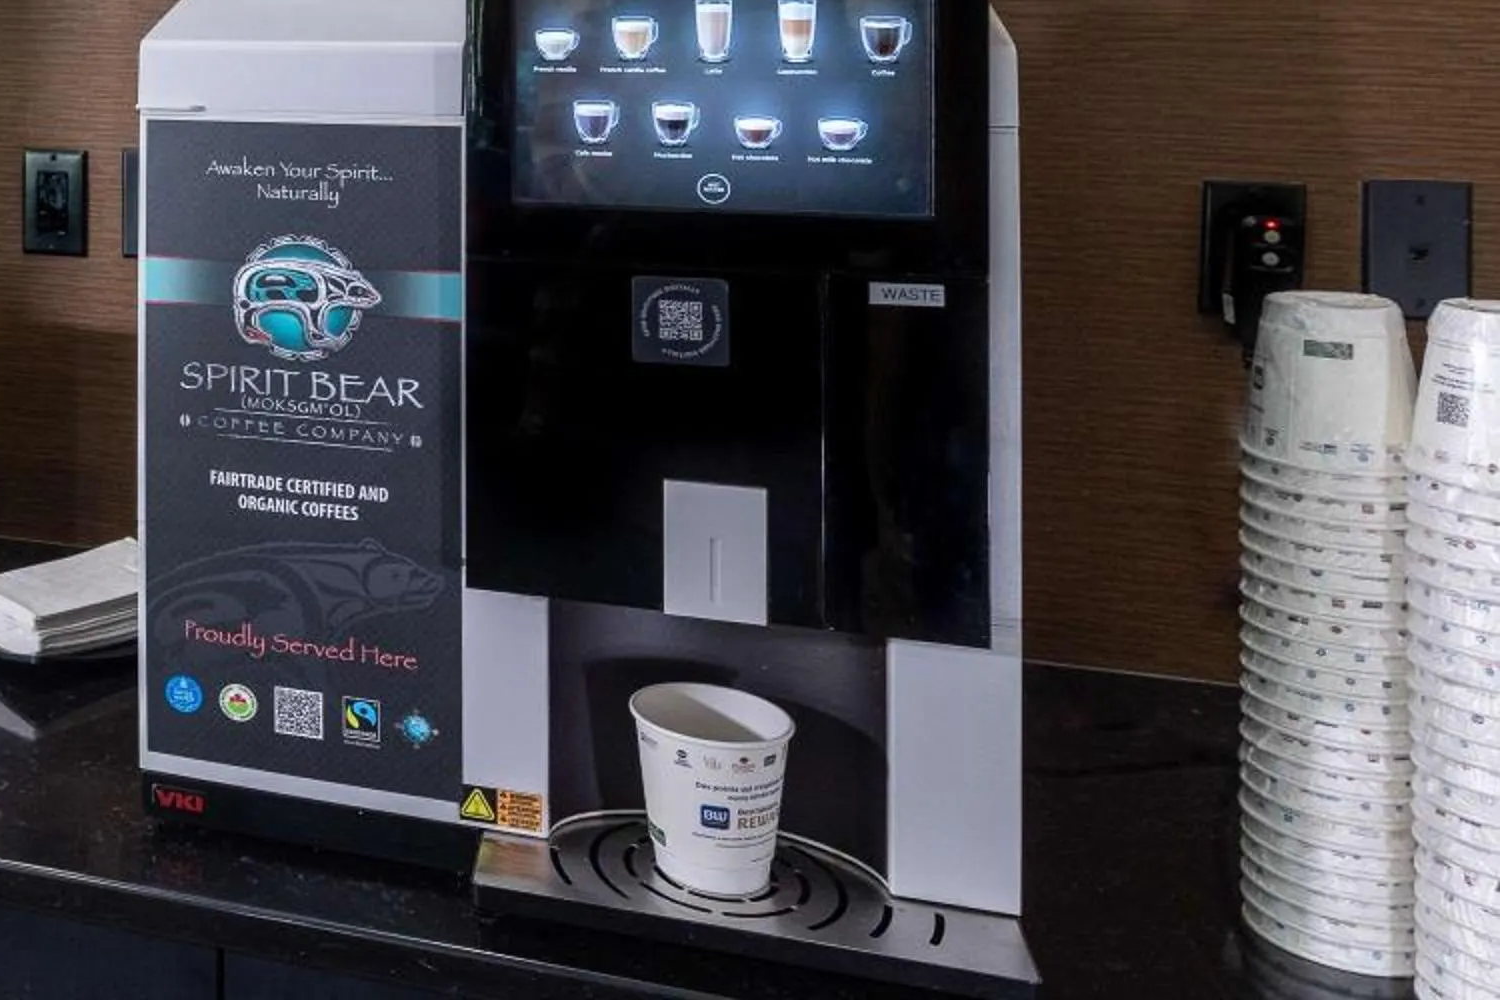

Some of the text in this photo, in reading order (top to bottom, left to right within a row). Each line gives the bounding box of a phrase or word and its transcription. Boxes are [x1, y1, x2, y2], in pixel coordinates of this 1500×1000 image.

[205, 155, 393, 188] Awaken Your Spirit...
[257, 180, 340, 209] Naturally
[881, 287, 941, 302] WASTE
[180, 361, 424, 409] SPIRIT BEAR
[198, 415, 404, 446] COFFEE COMPANY
[209, 469, 389, 503] FAIRTRADE CERTIFIED AND
[238, 493, 360, 521] ORGANIC COFFEES
[184, 619, 419, 670] Proudly Served Here
